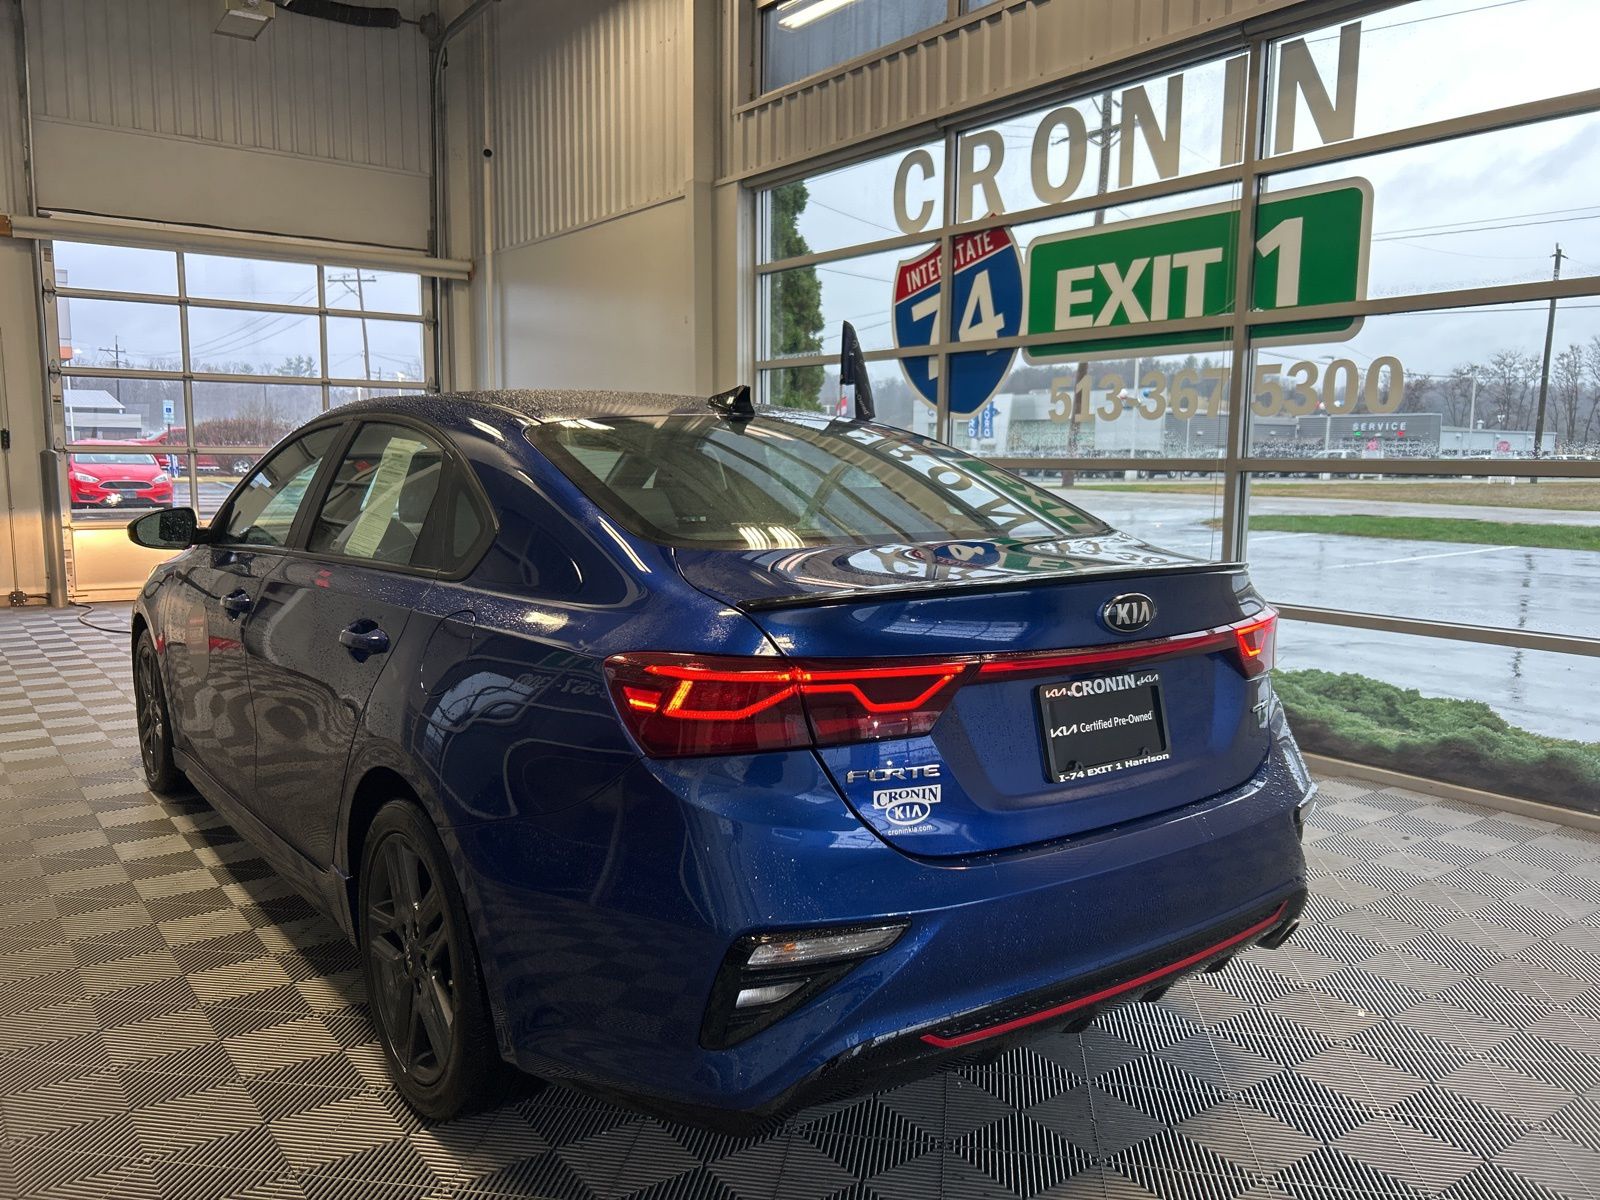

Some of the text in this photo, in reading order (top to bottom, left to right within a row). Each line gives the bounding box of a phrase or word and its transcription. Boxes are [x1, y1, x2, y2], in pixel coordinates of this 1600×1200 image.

[893, 21, 1361, 234] CRONIN
[905, 230, 994, 293] INTETATE
[1055, 217, 1304, 331] EXIT 1
[911, 269, 1005, 381] 74
[1048, 356, 1404, 424] 513-3675300
[1352, 421, 1407, 432] SERVICE
[1115, 601, 1150, 625] KIA
[1071, 674, 1136, 698] CRONIN
[1080, 719, 1113, 733] Certified
[1113, 711, 1153, 727] Pre-Owned
[846, 764, 941, 783] FORTE
[1059, 753, 1170, 782] I-74 EXIT 1 Harrison
[876, 786, 939, 807] CRONIN
[894, 804, 922, 820] KIA
[887, 824, 933, 836] croninkia.com
